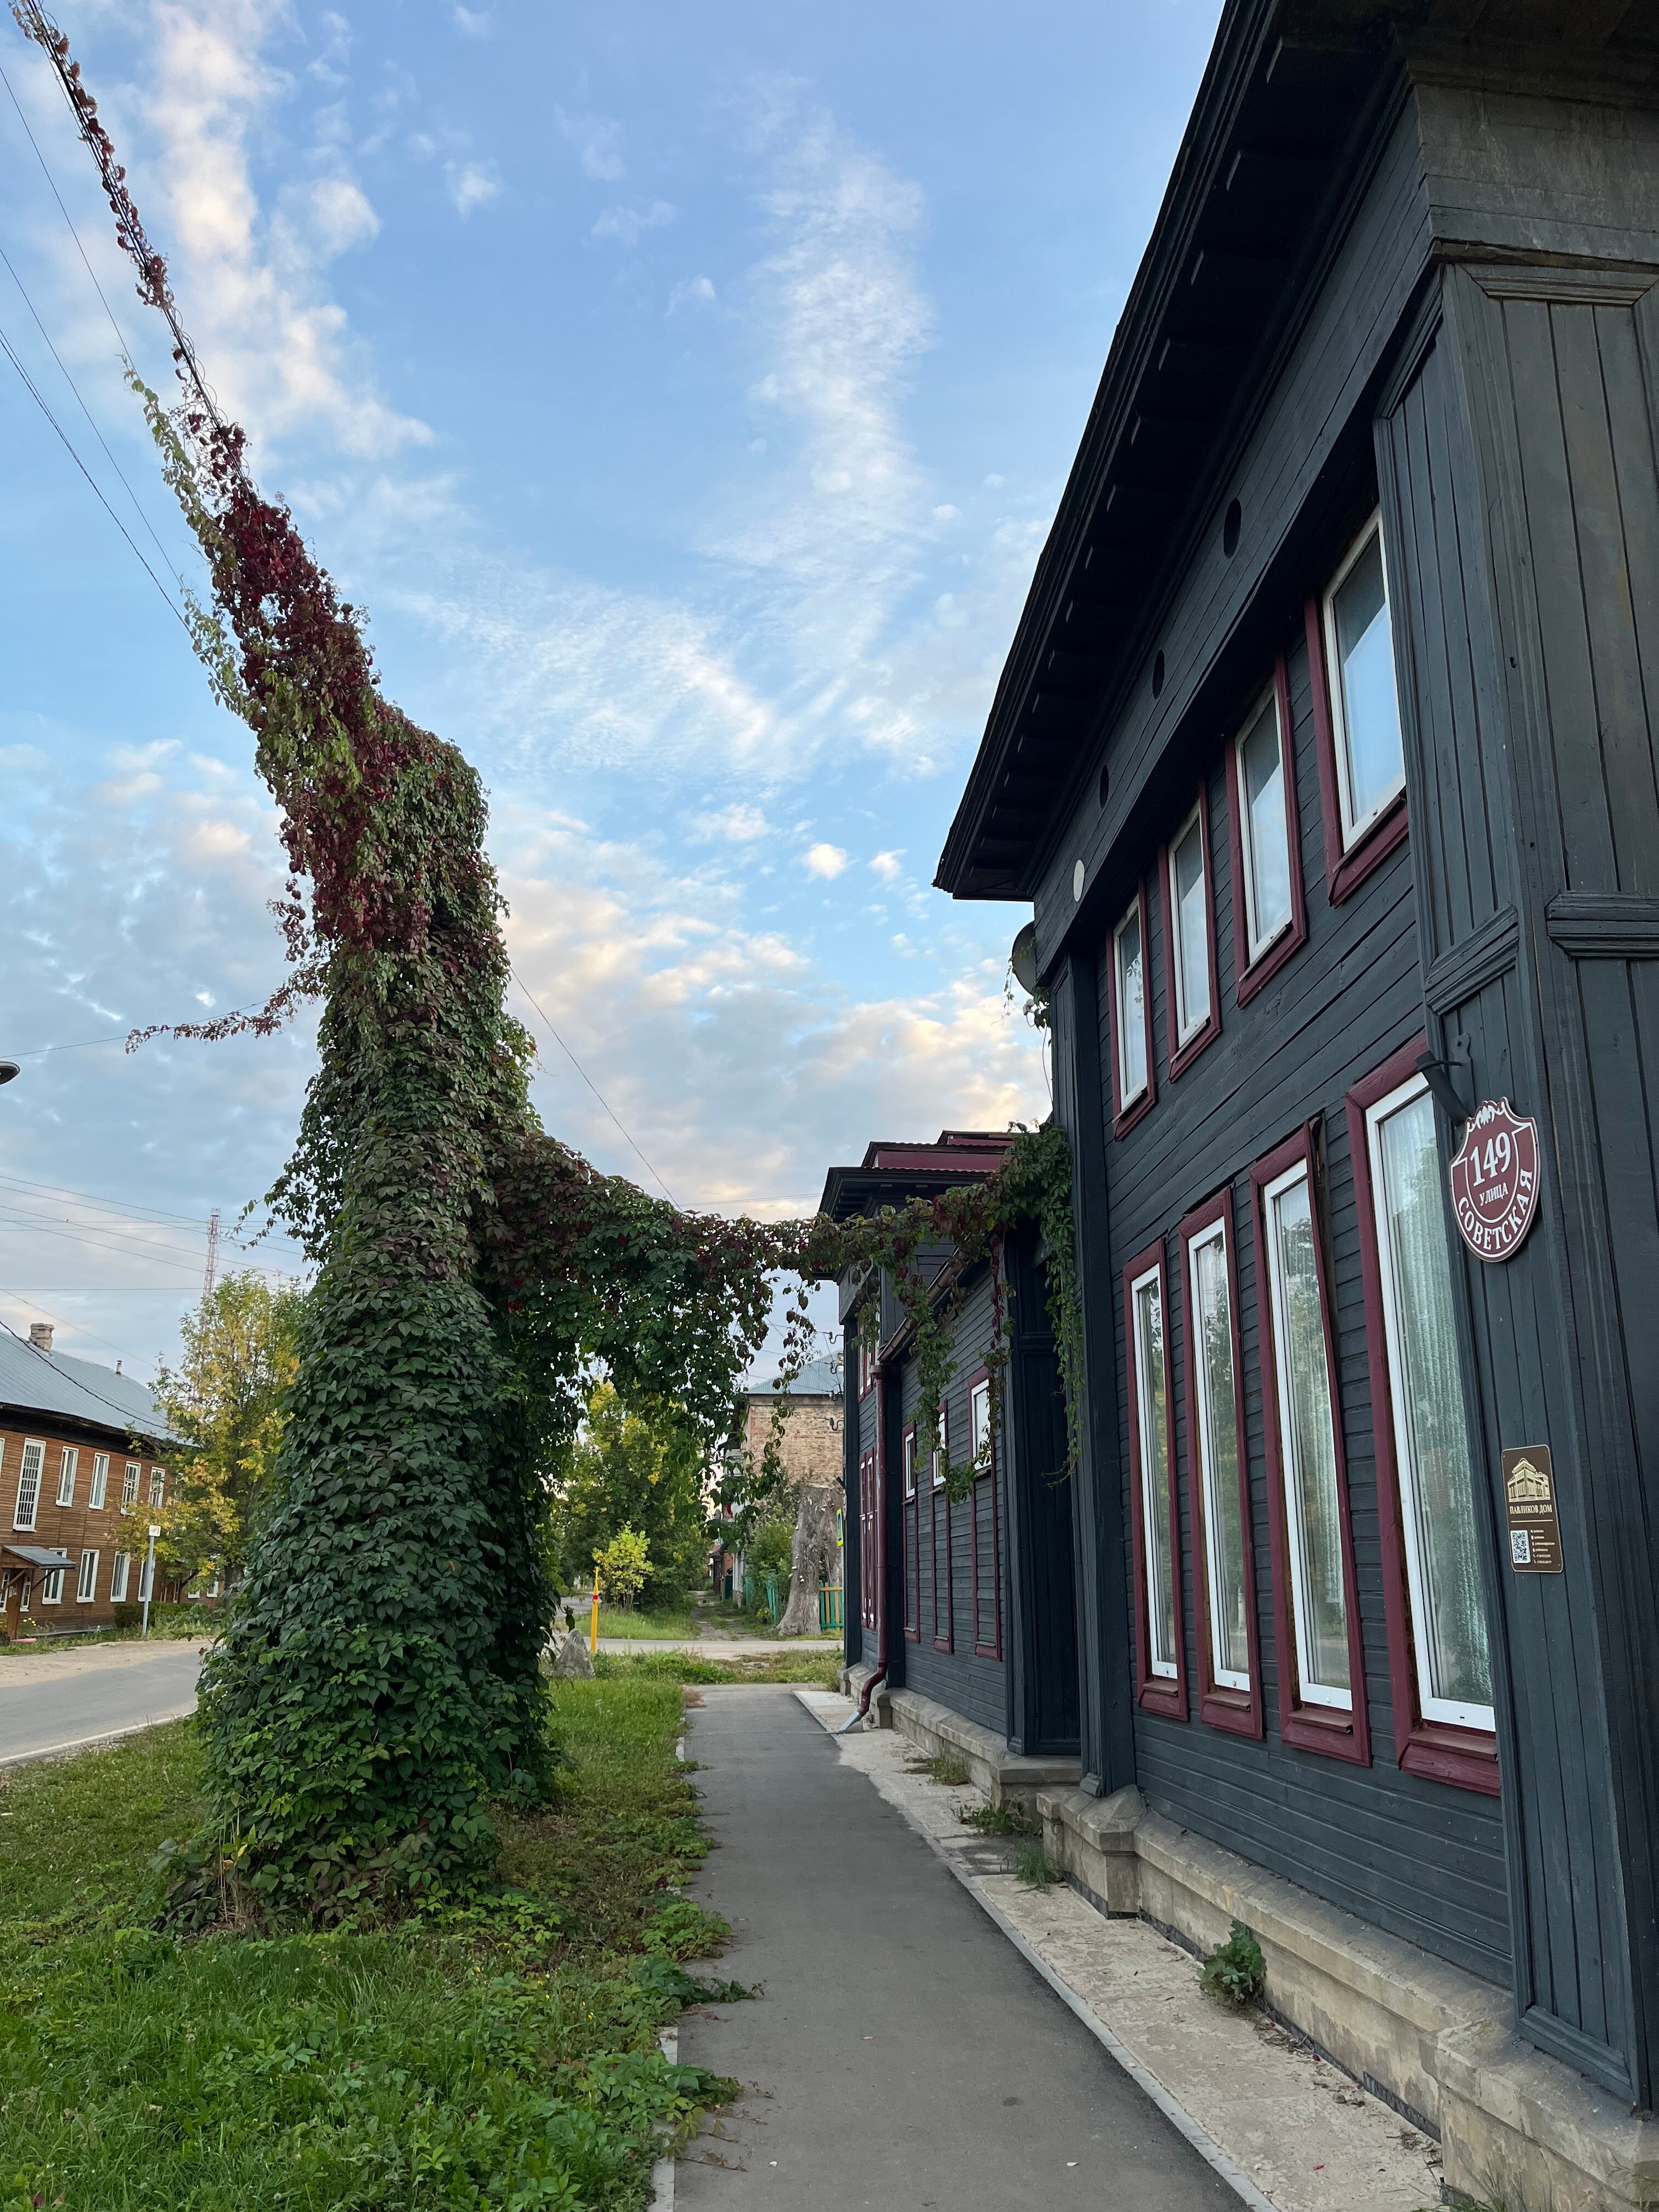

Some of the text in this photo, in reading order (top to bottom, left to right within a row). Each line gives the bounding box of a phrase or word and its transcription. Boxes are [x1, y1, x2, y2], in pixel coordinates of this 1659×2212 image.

[1470, 1132, 1511, 1187] 149
[1458, 1169, 1533, 1250] СОВЕТСКАЯ
[1479, 1182, 1509, 1206] УЛИЦА
[1510, 1504, 1553, 1515] ПАВЛИКОВ ДОМ
